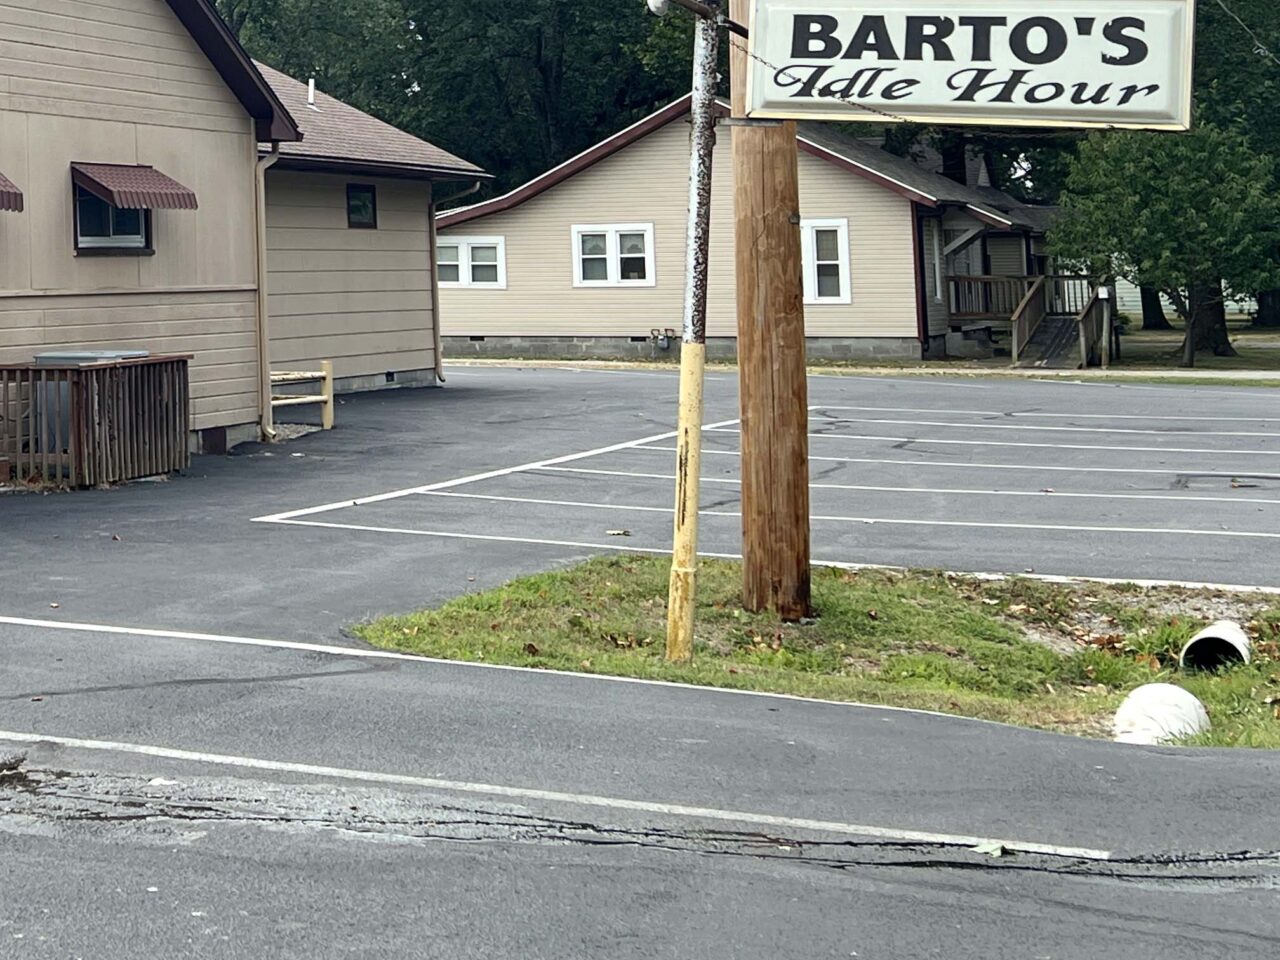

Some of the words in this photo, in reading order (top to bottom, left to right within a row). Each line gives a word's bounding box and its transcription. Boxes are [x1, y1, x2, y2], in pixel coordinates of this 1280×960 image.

[790, 13, 1149, 66] BARTO'S
[773, 64, 921, 100] Idle
[946, 68, 1160, 107] Hour
